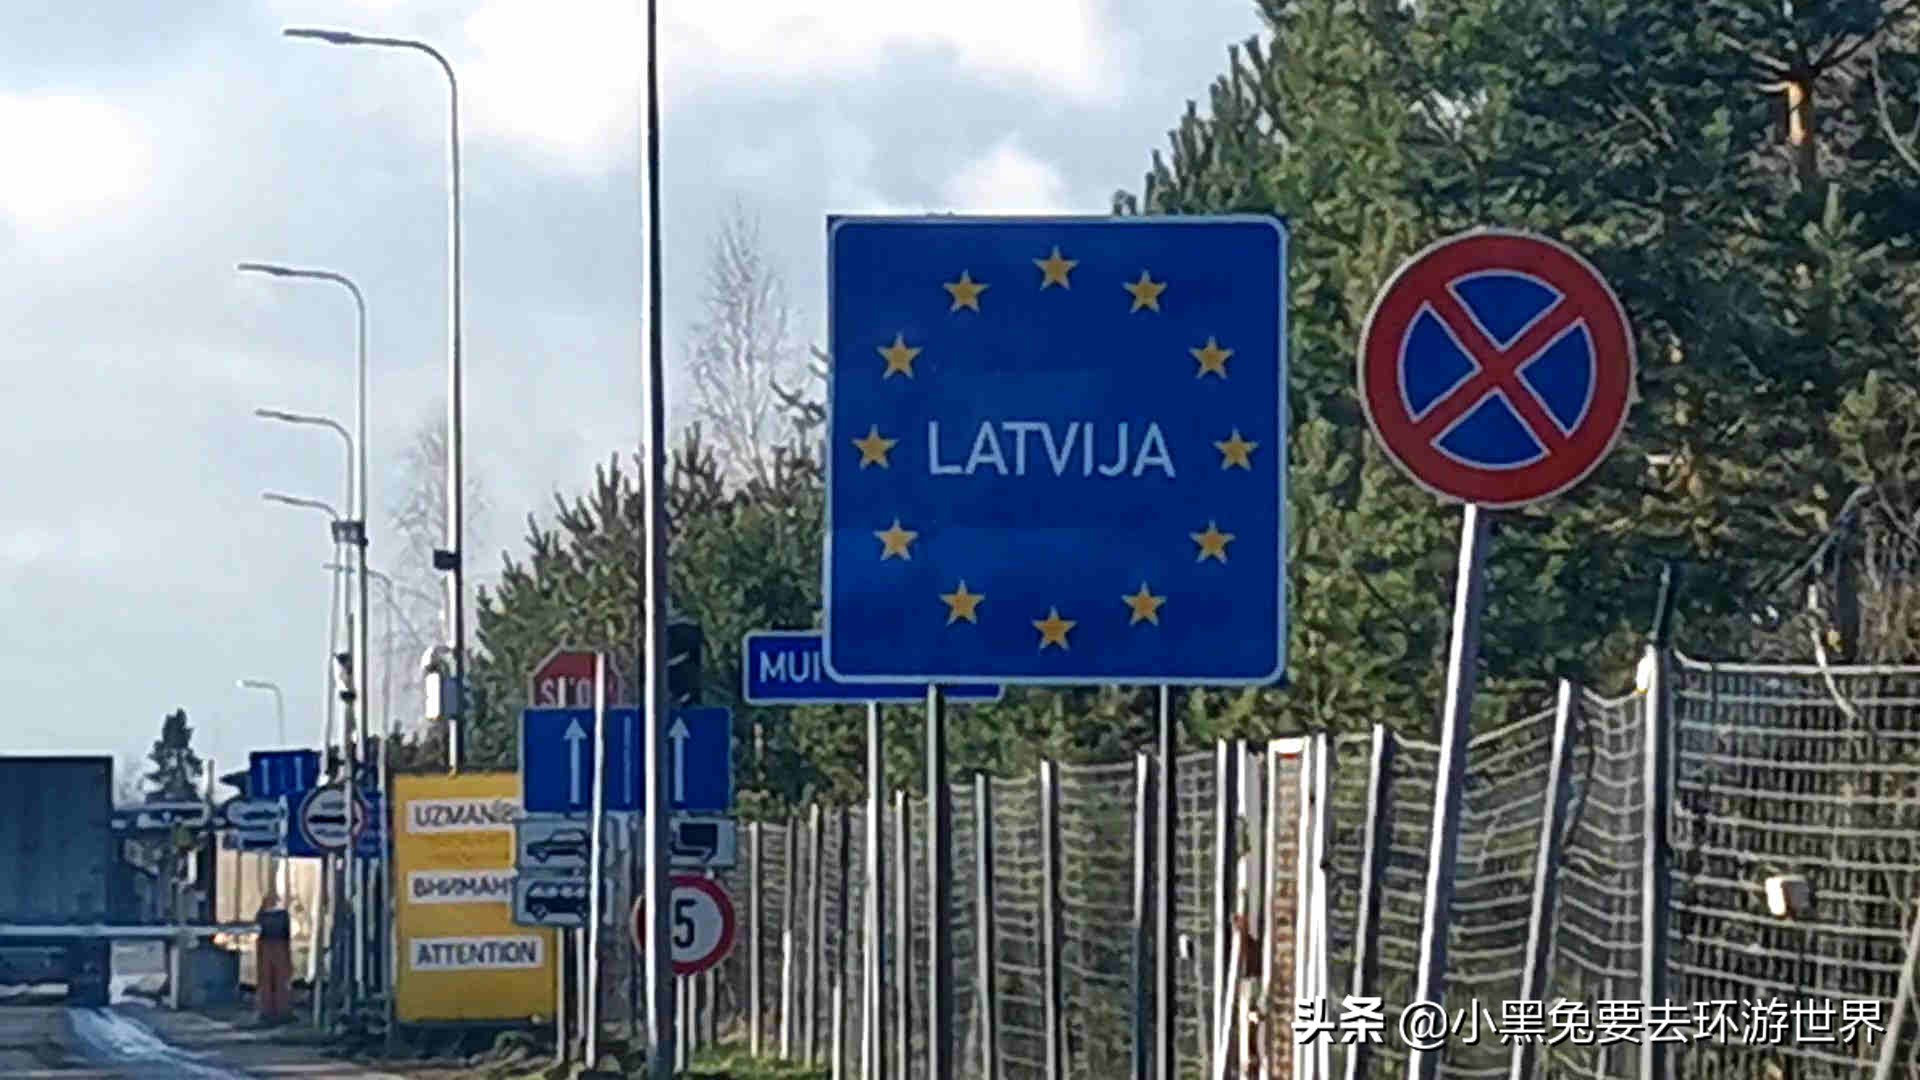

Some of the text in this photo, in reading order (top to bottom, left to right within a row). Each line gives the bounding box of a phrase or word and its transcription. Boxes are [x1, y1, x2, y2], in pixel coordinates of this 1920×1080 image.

[928, 420, 1176, 479] LATVIJA
[760, 650, 822, 683] MUI
[413, 876, 512, 898] ВНИМАН
[673, 897, 697, 949] 5
[416, 939, 538, 965] ATTENTION
